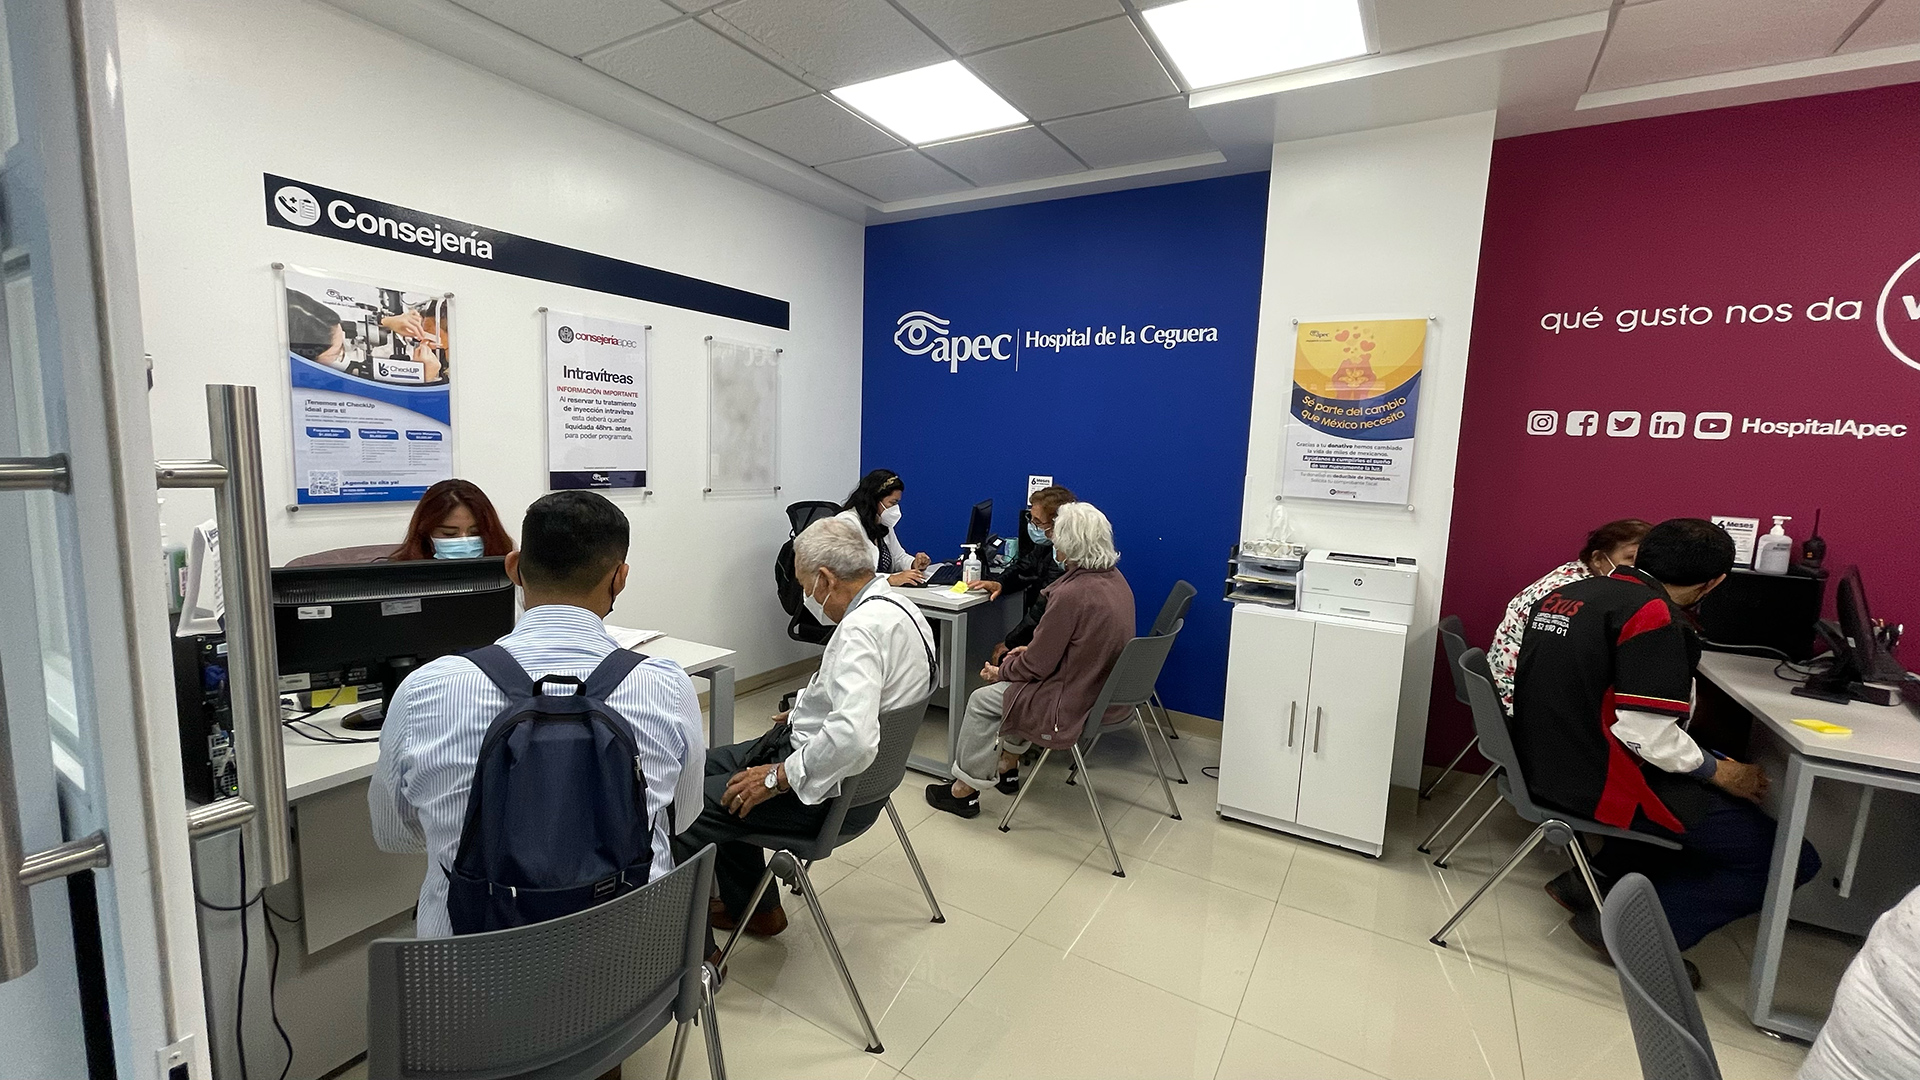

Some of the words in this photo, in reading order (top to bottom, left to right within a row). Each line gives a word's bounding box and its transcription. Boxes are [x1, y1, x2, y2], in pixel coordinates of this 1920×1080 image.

[327, 199, 493, 260] Consejería
[1540, 306, 1604, 335] qué
[1615, 302, 1714, 333] gusto
[1725, 301, 1793, 325] nos
[1805, 296, 1863, 322] da
[931, 333, 1012, 374] apec
[1025, 327, 1091, 353] Hospital
[1094, 325, 1116, 346] de
[1120, 325, 1136, 345] la
[1139, 325, 1218, 350] Ceguera
[563, 365, 634, 385] Intravítreas
[556, 385, 602, 395] INFORMACIÓN
[602, 390, 639, 398] IMPORTANTE
[559, 395, 566, 403] Al
[603, 399, 637, 408] tratamiento
[1302, 395, 1315, 407] Sé
[1314, 402, 1344, 416] parte
[1345, 405, 1363, 416] del
[1364, 396, 1407, 415] cambio
[573, 406, 604, 414] inyección
[604, 408, 634, 416] intravítrea
[607, 417, 627, 425] quedar
[1301, 408, 1320, 423] que
[1320, 416, 1358, 430] México
[1359, 410, 1405, 429] necesita
[565, 423, 594, 431] liquidada
[1741, 417, 1908, 440] HospitalApec
[564, 432, 579, 440] para
[580, 432, 598, 440] poder
[1030, 477, 1036, 485] 6
[1726, 521, 1753, 529] Meses
[1556, 627, 1568, 637] 01
